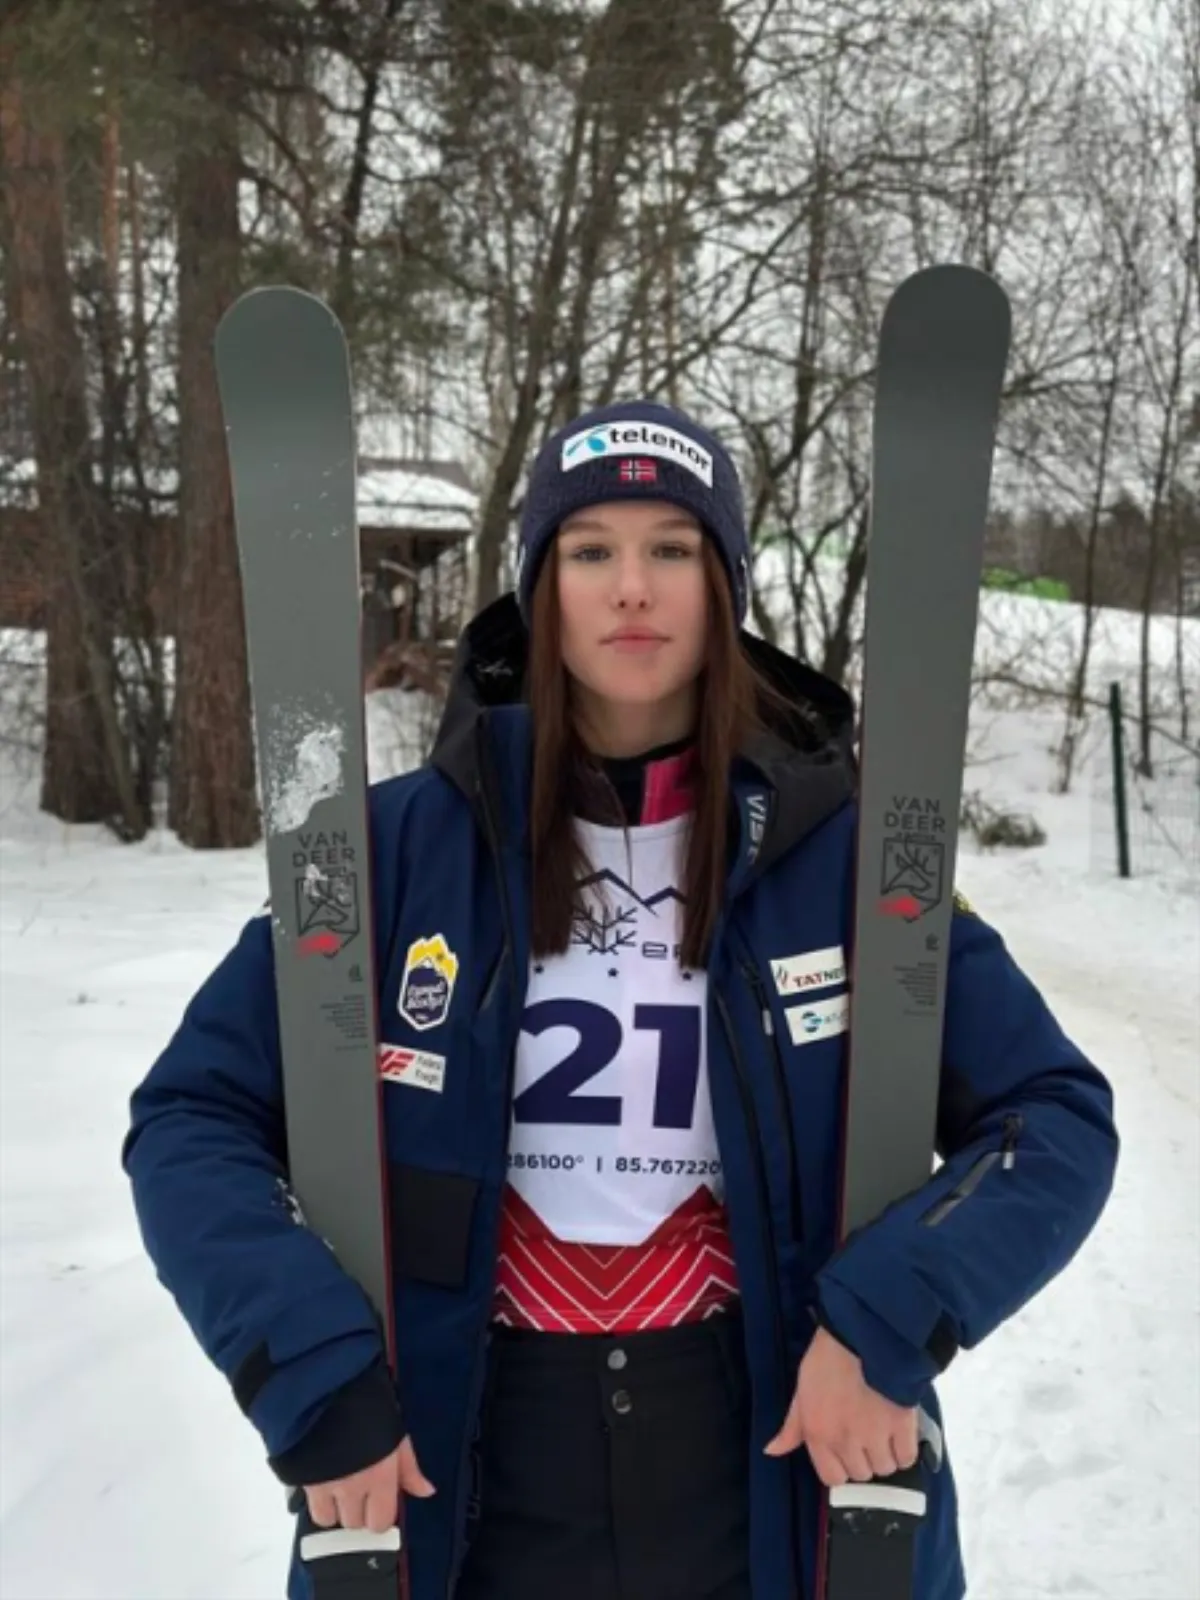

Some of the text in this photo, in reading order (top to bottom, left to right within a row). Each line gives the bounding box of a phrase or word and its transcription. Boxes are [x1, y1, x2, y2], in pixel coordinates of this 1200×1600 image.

[609, 427, 711, 470] telenor
[892, 795, 941, 814] VAN
[884, 812, 946, 833] DEER
[297, 829, 348, 849] VAN
[293, 847, 356, 868] DEER
[512, 997, 702, 1129] 21
